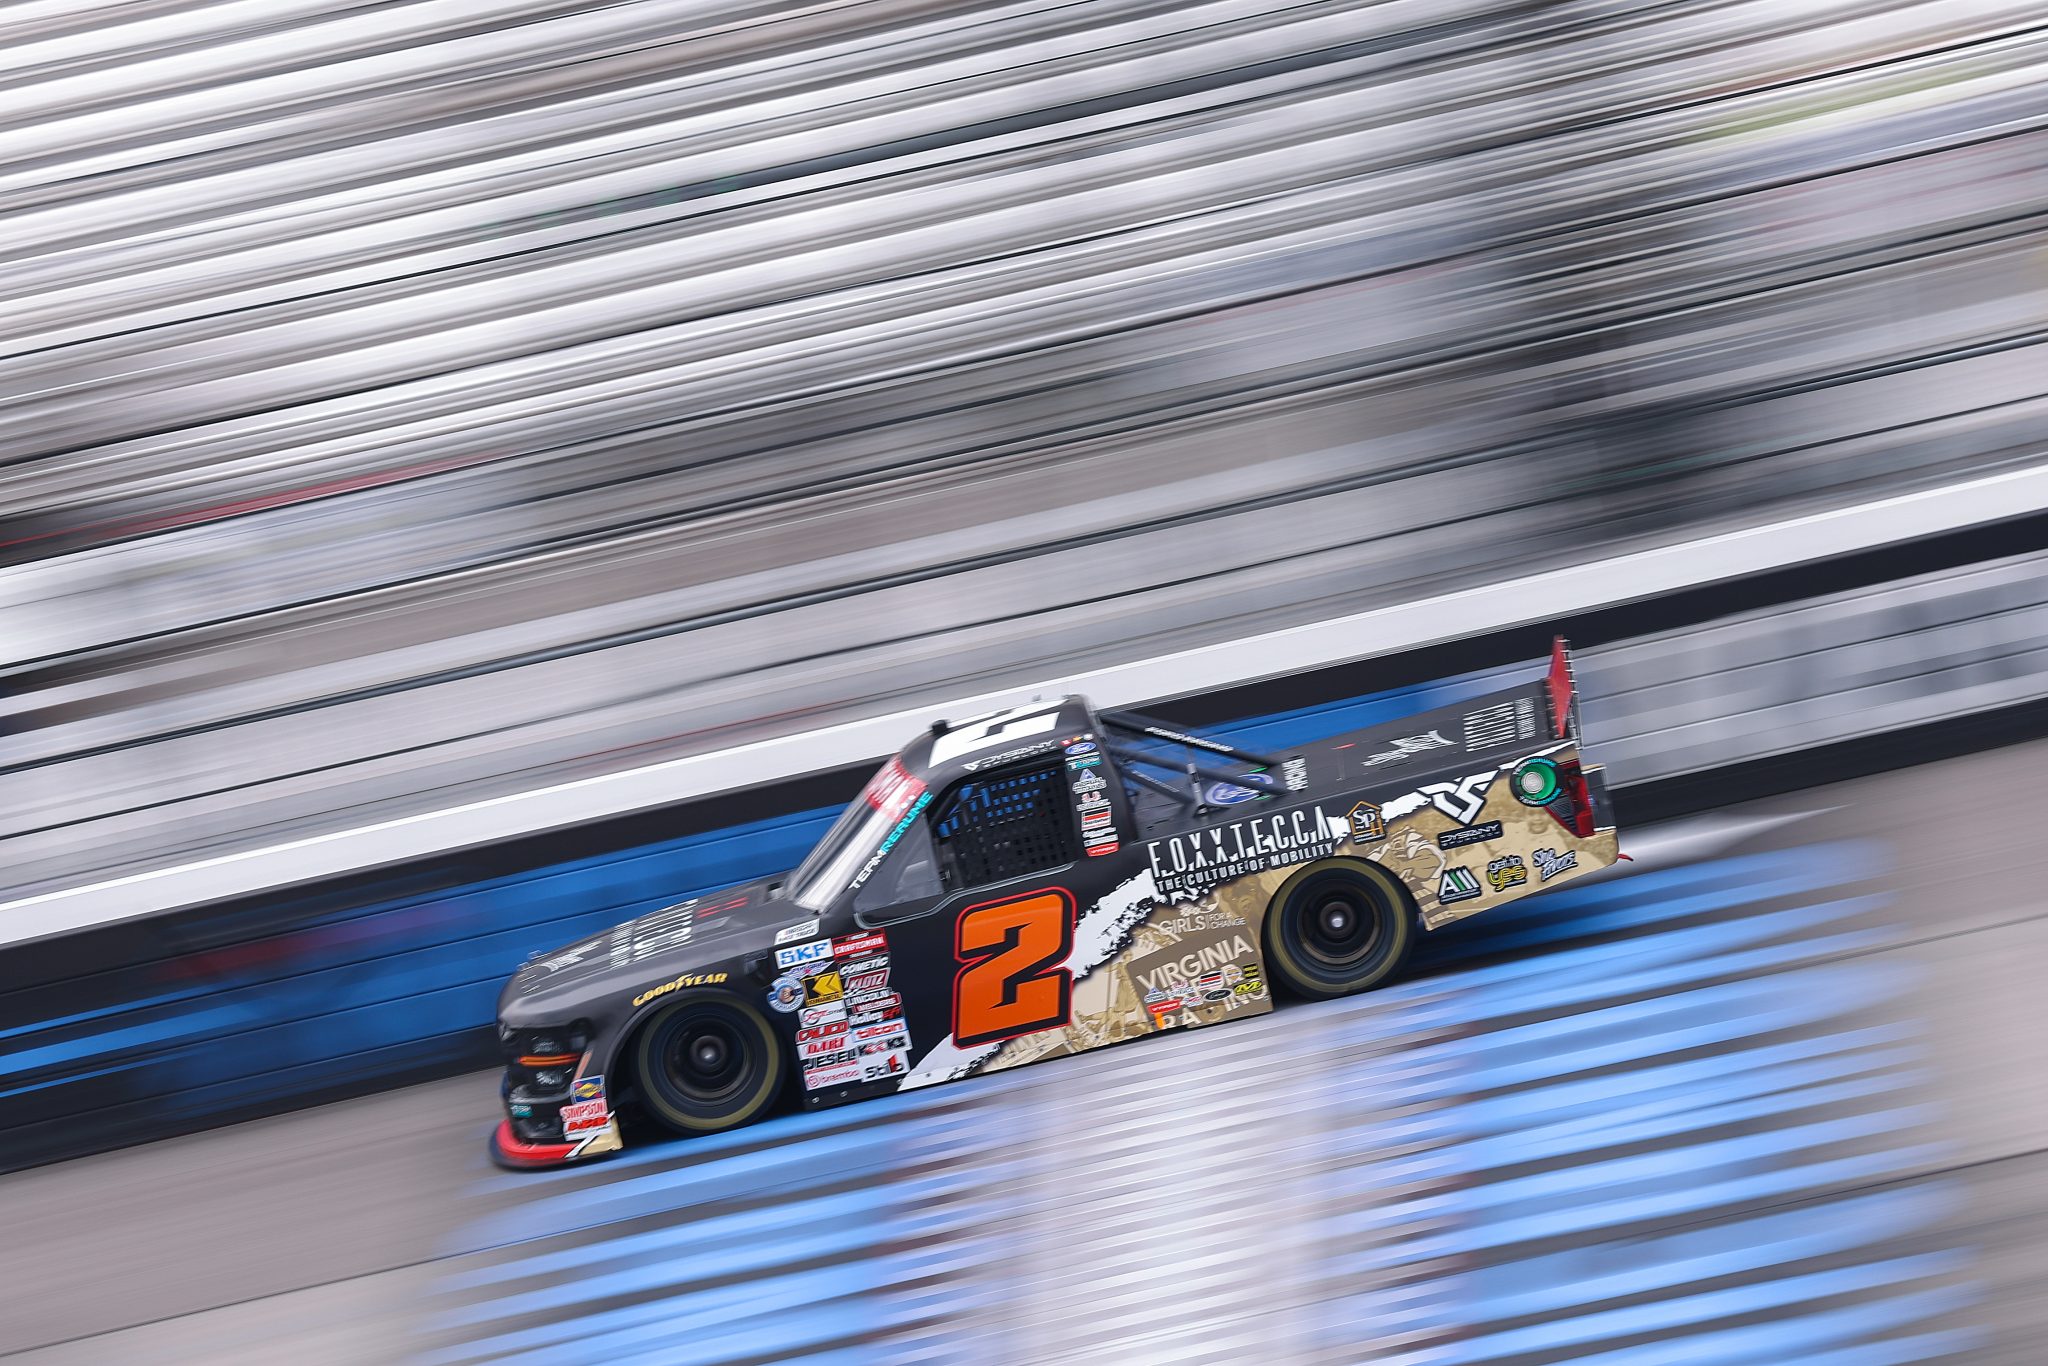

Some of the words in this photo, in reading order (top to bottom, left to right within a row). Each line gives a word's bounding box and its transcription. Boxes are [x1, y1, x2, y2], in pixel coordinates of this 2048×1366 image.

[1147, 805, 1334, 878] FOXXTECCA
[1156, 878, 1182, 893] THE
[1184, 863, 1246, 886] CULTURE
[1249, 858, 1266, 872] OF
[1270, 842, 1335, 867] MOBILITY
[1487, 865, 1527, 891] yes
[1159, 915, 1207, 934] GIRLS
[1209, 912, 1226, 922] FOR
[1211, 917, 1247, 930] CHANGE
[780, 942, 829, 966] SKF
[839, 956, 889, 976] COMETIC
[1136, 934, 1255, 988] VIRGINIA
[954, 889, 1072, 1046] 2
[632, 971, 729, 1007] GOODYEAR
[845, 989, 891, 1007] LINCOLN
[848, 1009, 884, 1025] Holley
[803, 1047, 858, 1071] JESEL
[820, 1069, 861, 1084] brembo
